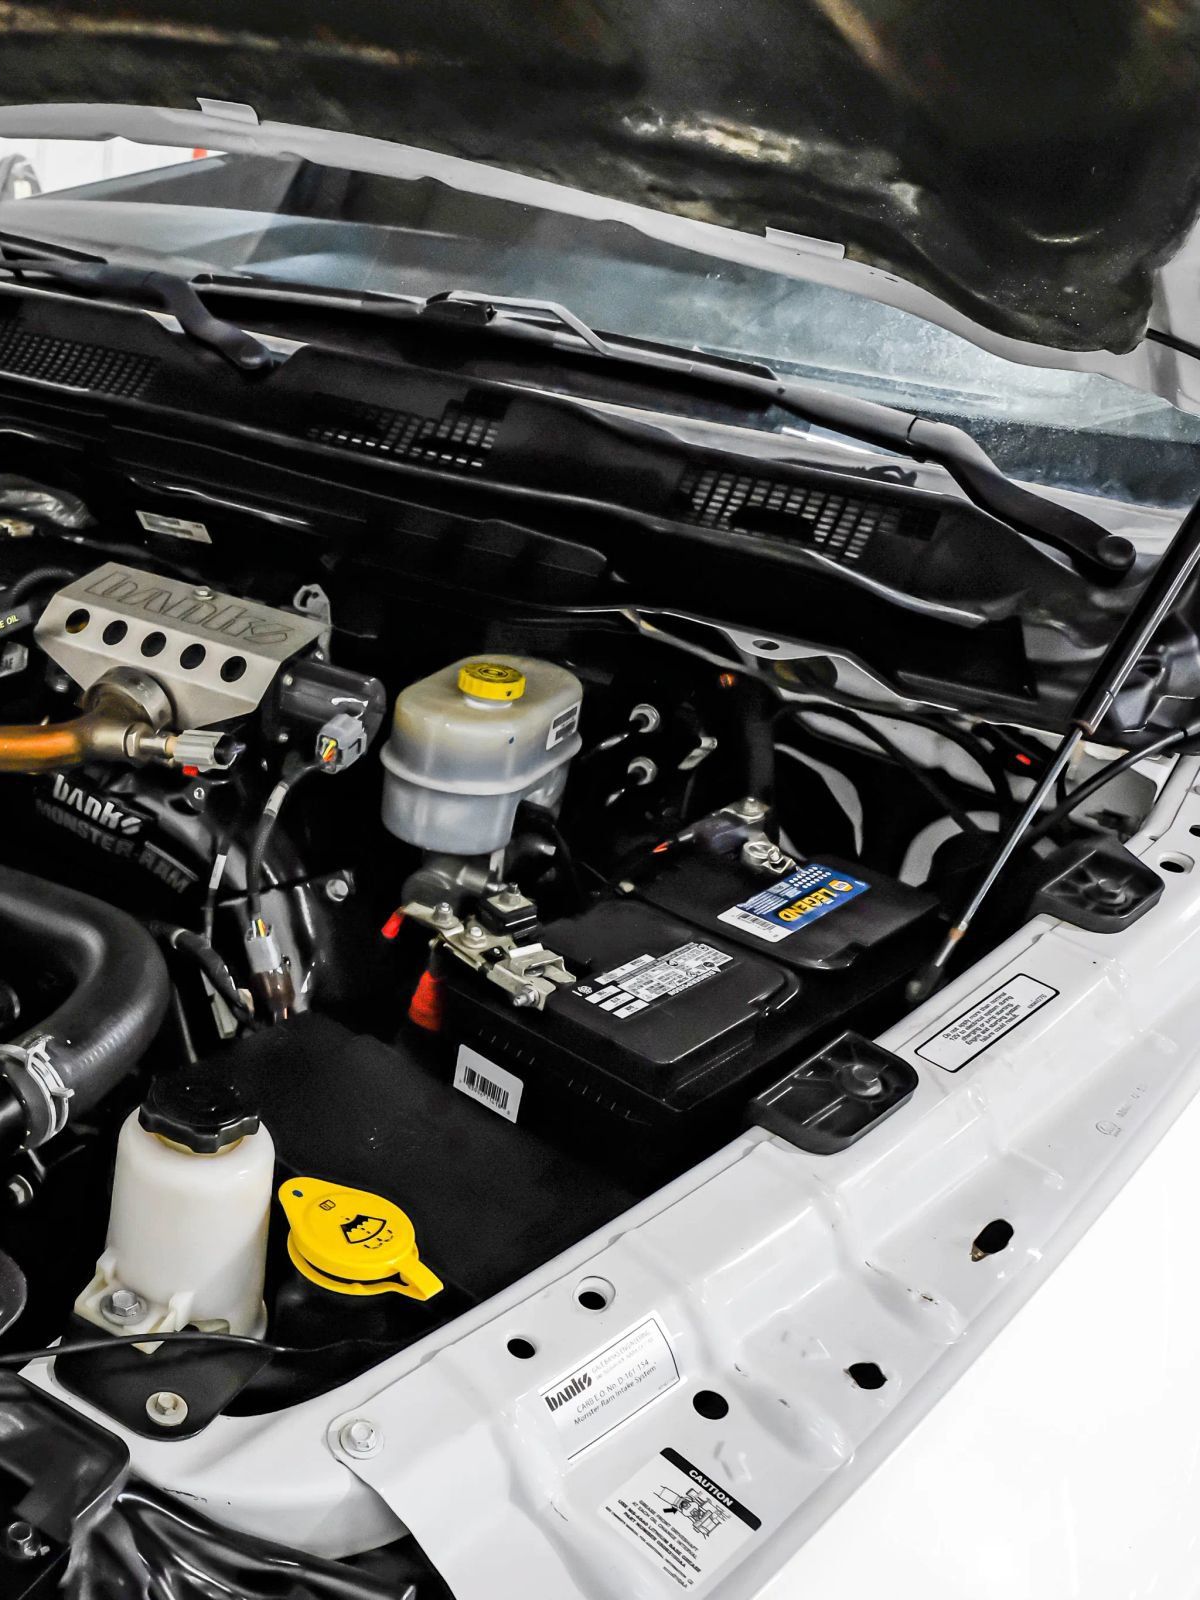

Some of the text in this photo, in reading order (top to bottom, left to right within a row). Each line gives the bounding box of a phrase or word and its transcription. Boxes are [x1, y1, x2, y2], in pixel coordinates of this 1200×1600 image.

[6, 615, 20, 624] OIL
[52, 774, 142, 835] banks
[778, 887, 837, 922] LEGEND
[544, 1372, 592, 1412] banks
[688, 1468, 735, 1508] CAUTION
